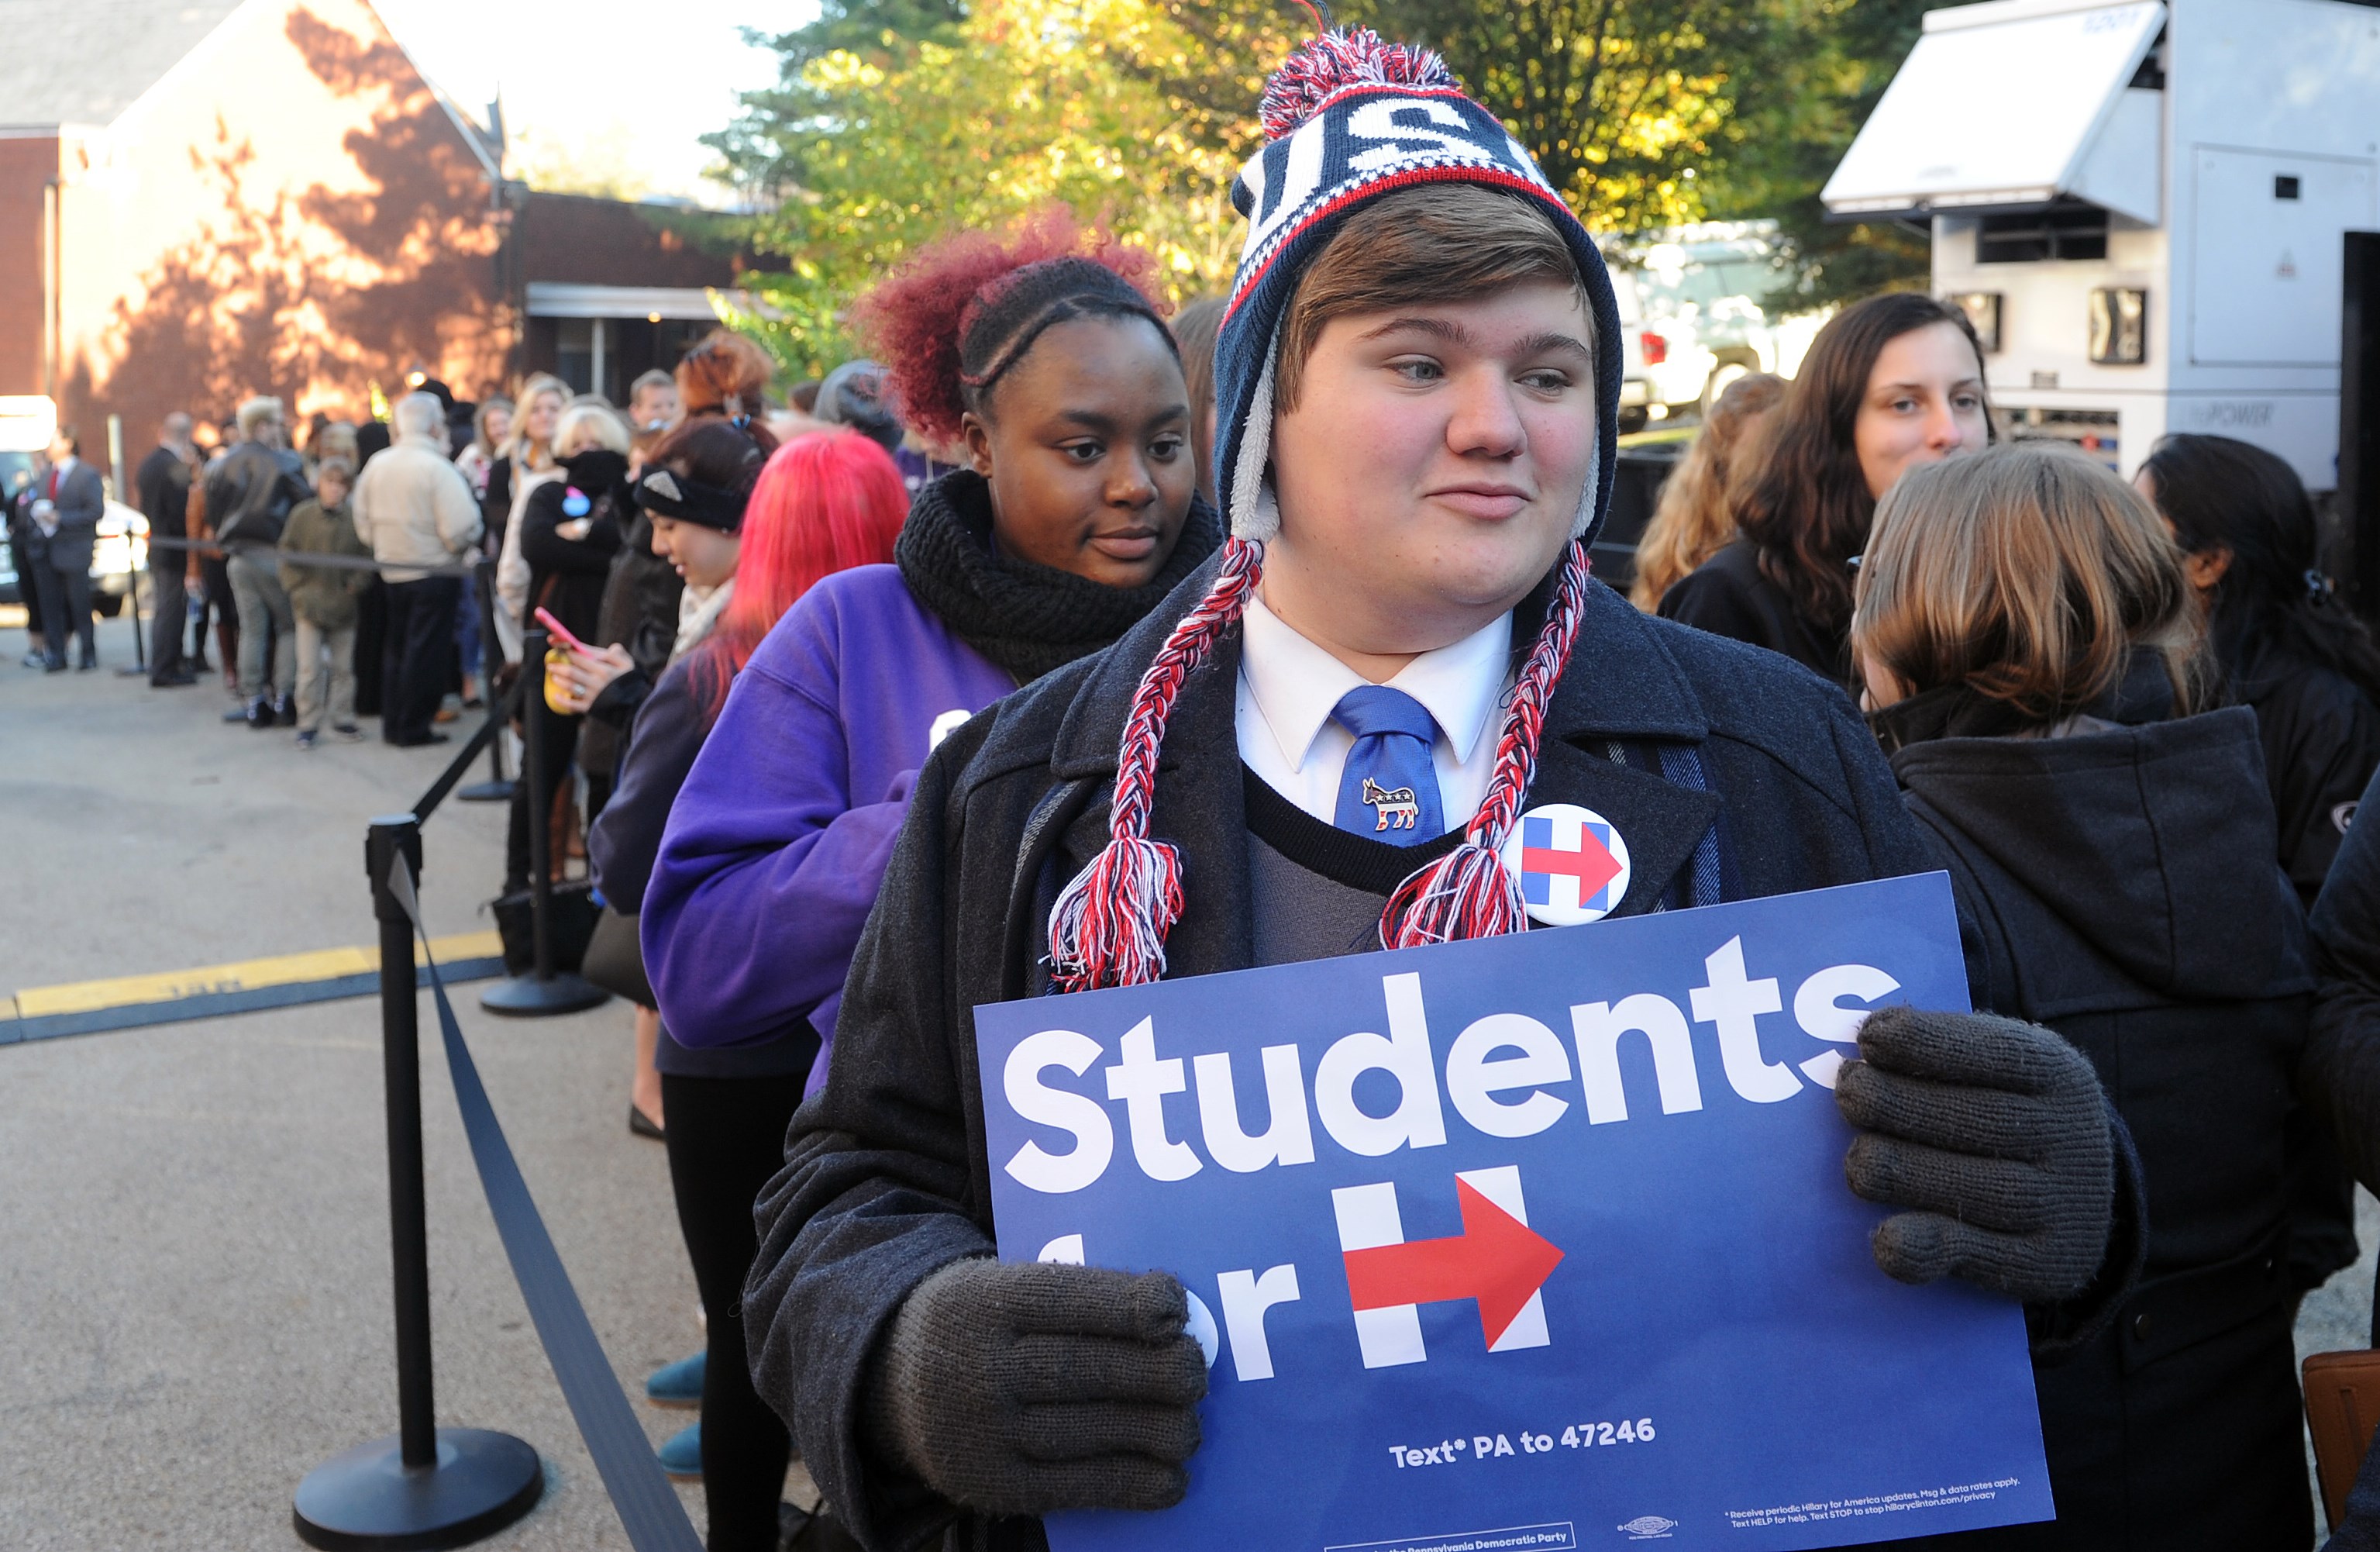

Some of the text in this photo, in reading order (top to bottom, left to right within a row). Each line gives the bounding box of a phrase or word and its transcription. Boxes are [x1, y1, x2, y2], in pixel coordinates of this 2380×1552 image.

[1003, 934, 1901, 1194] Students
[1473, 1434, 1515, 1459] PA
[1519, 1431, 1554, 1454] to
[1560, 1418, 1655, 1448] 47246
[1730, 1509, 1765, 1519] Receive
[1765, 1505, 1800, 1517] periodic
[1802, 1502, 1828, 1512] Hillary
[1830, 1500, 1842, 1509] for
[1844, 1496, 1880, 1506] America
[1920, 1489, 1938, 1499] Msg
[1940, 1487, 1947, 1495] &
[1948, 1485, 1969, 1495] data
[1970, 1482, 1993, 1492] rates
[1994, 1477, 2020, 1488] apply.
[1731, 1491, 1996, 1528] Text HELP for help. Text STOP to stop hillaryclinton.com/privacy
[1475, 1535, 1536, 1550] Democratic
[1537, 1532, 1567, 1543] Party
